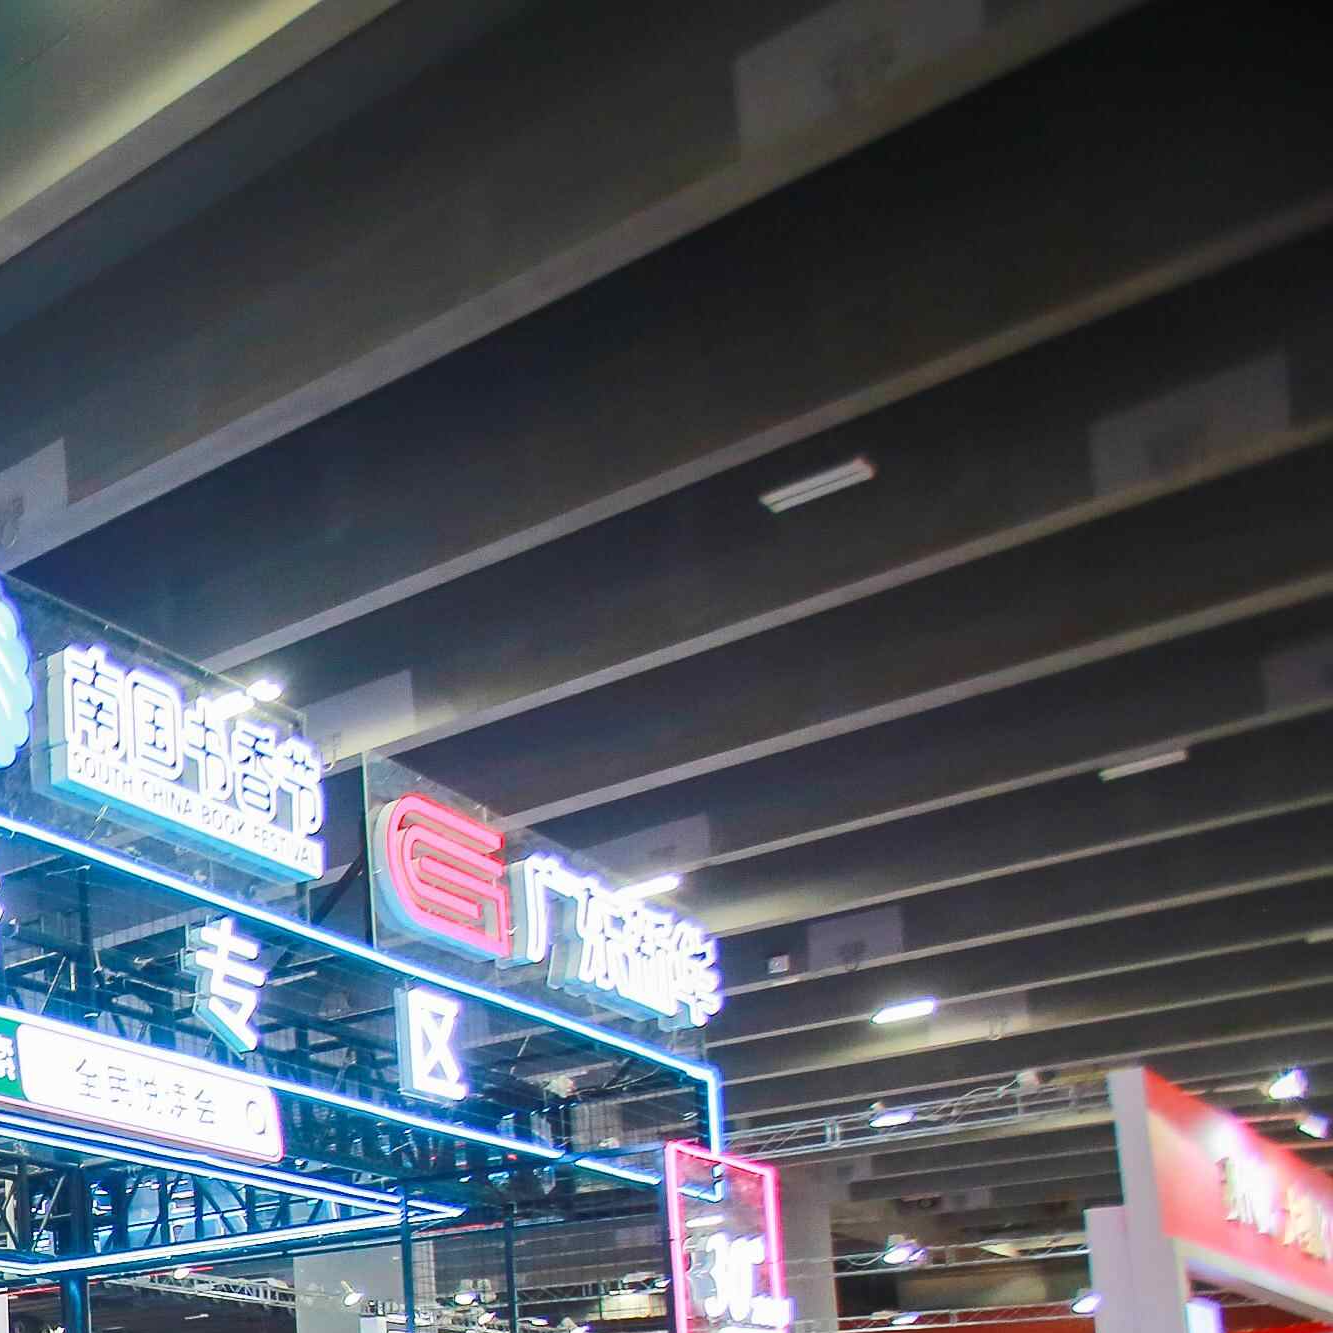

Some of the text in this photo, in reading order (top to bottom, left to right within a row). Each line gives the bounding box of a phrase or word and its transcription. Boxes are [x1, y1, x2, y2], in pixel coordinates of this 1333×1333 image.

[65, 646, 323, 834] 南国书香节
[72, 751, 133, 788] SOUTH
[141, 780, 193, 816] CHINA
[201, 804, 246, 835] BOOK
